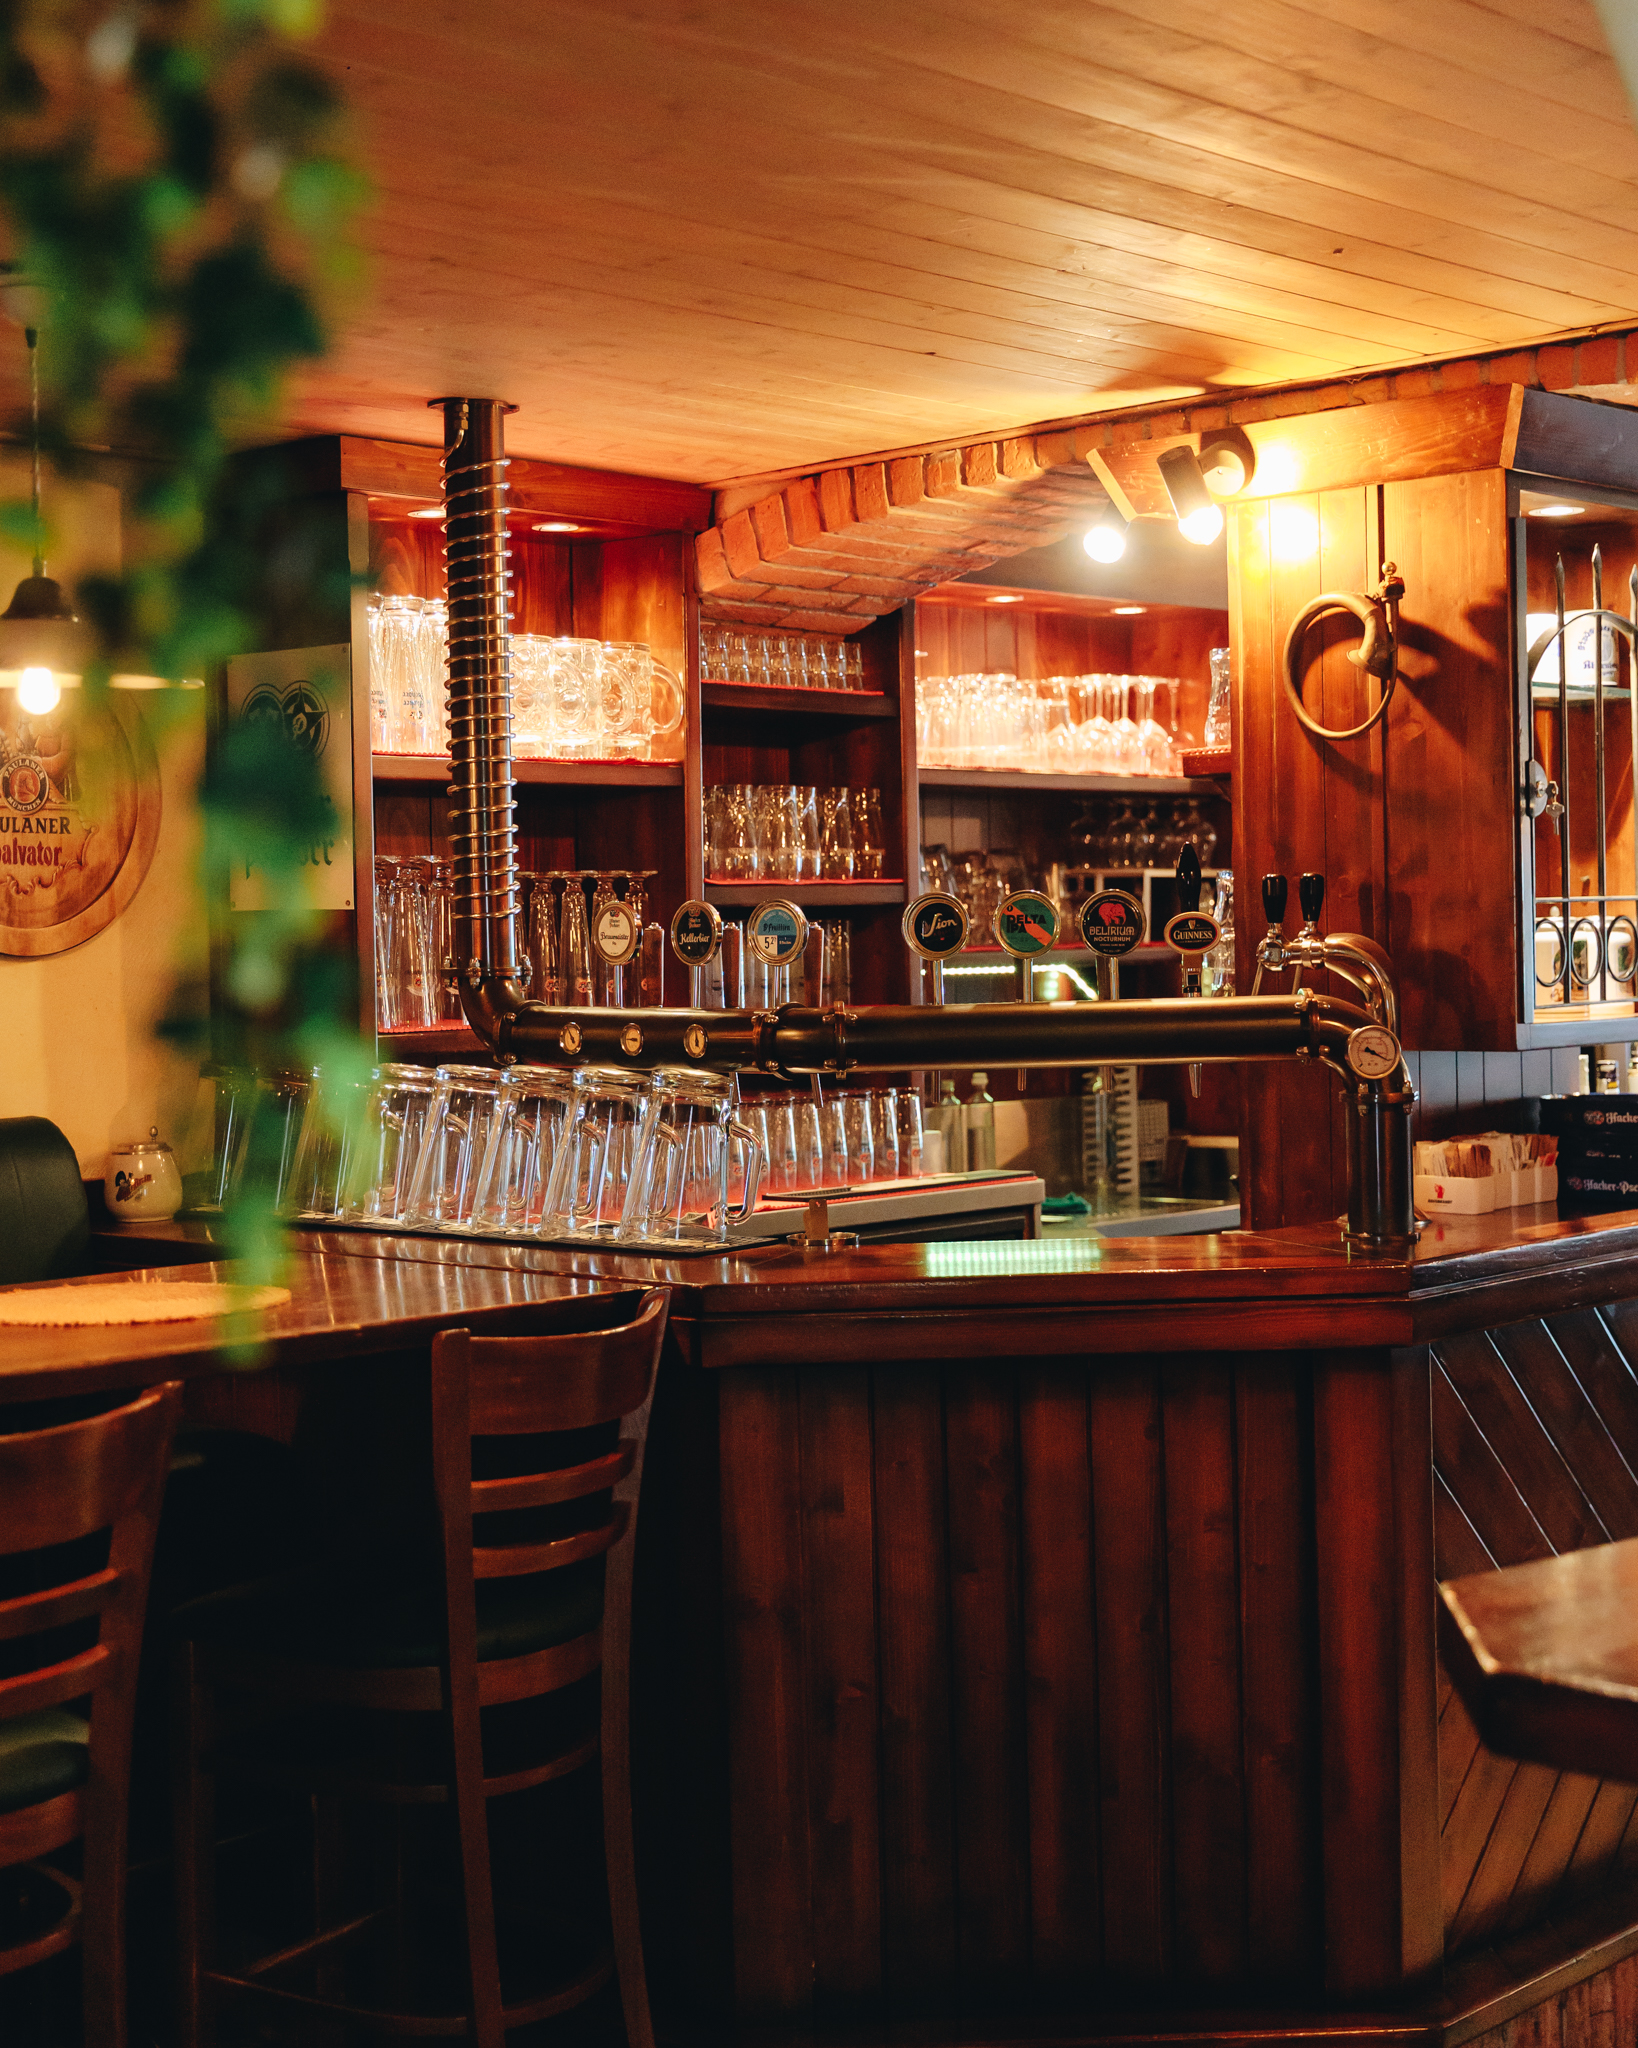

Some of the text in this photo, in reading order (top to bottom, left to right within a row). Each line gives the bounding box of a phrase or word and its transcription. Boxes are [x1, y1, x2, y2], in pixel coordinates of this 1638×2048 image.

[5, 759, 45, 779] PAULANER
[0, 837, 62, 867] alvator
[921, 912, 957, 937] Sion
[1006, 914, 1047, 924] DELTA
[1006, 922, 1027, 933] IPA
[1089, 926, 1135, 936] DELIRIUM
[679, 932, 710, 945] Kellerbier
[1173, 930, 1213, 940] GUINNESS
